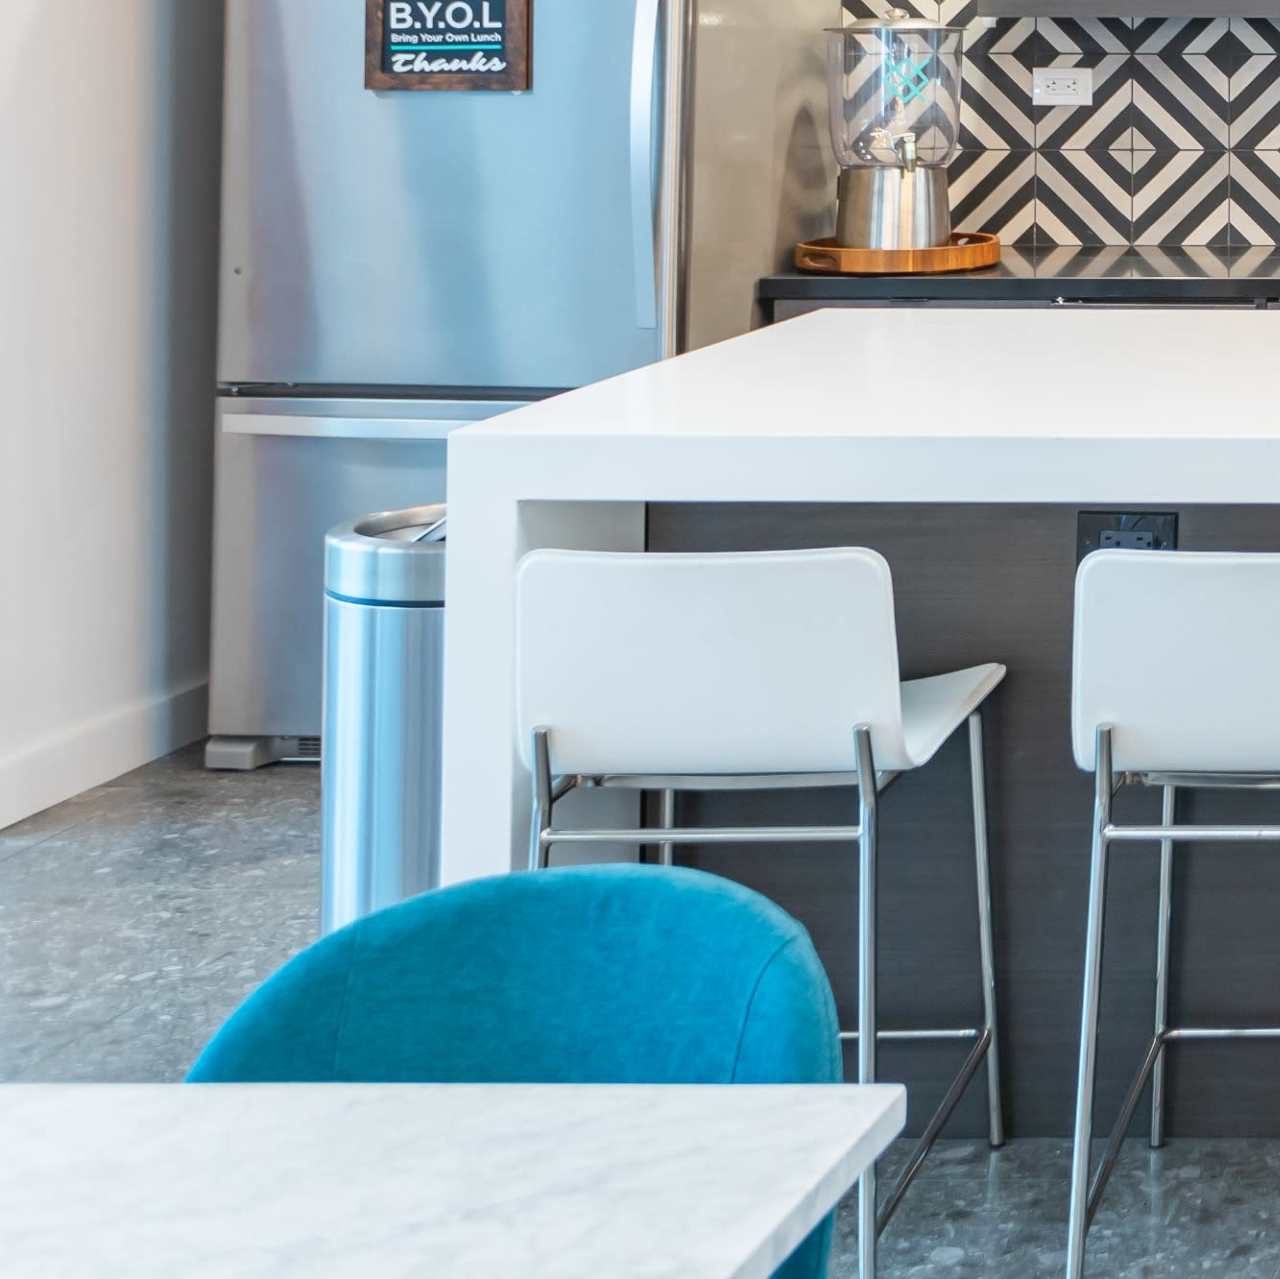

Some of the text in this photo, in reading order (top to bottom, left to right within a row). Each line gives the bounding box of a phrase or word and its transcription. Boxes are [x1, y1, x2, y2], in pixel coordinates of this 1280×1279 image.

[389, 1, 503, 29] B.Y.O.L
[391, 32, 502, 44] Bring Your Own Lunch
[391, 51, 507, 73] Thanks
